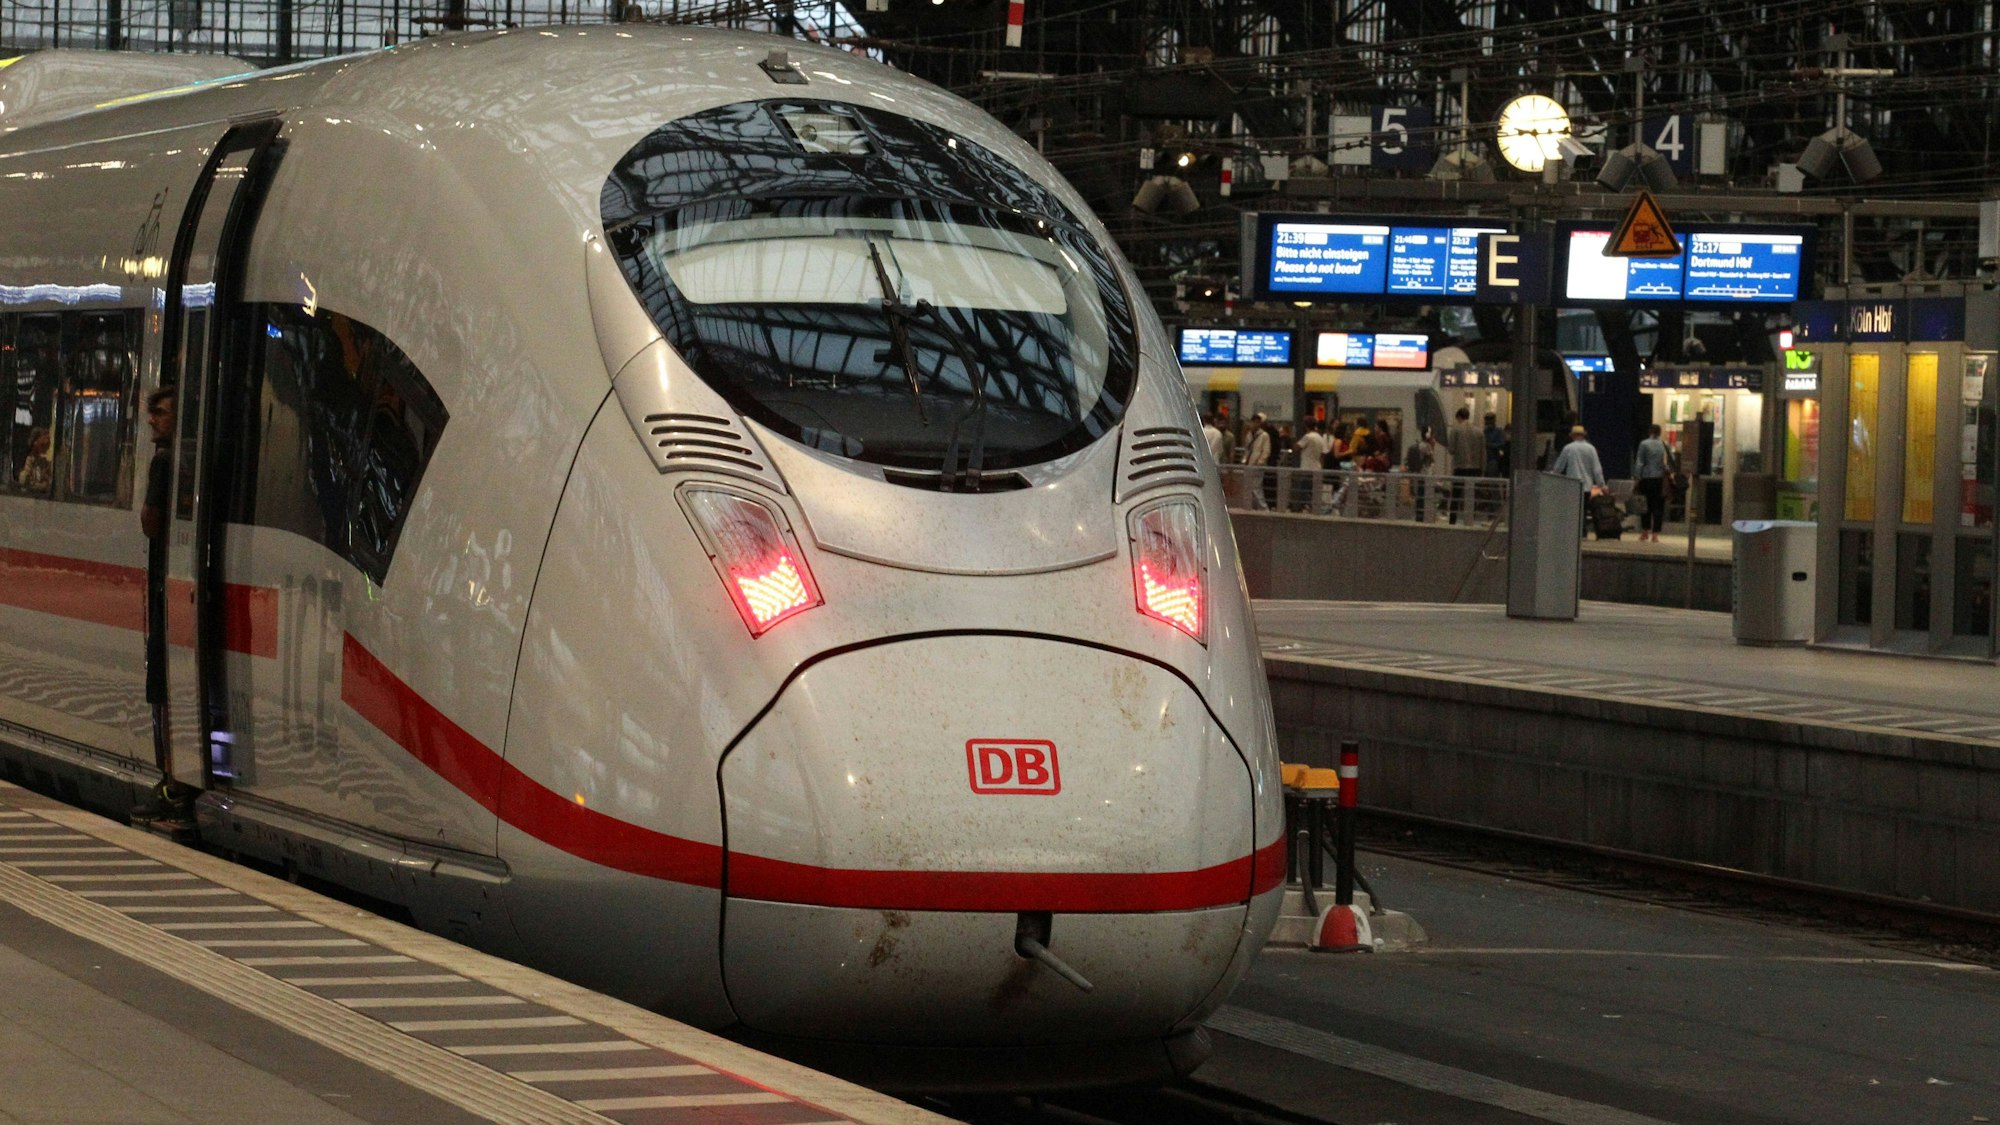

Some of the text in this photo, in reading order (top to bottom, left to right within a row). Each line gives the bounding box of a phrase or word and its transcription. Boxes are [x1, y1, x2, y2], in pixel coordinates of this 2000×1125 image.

[1380, 108, 1408, 154] 5
[1655, 114, 1684, 160] 4
[1277, 232, 1304, 244] 21:39
[1692, 242, 1719, 253] 21:17
[1276, 246, 1369, 262] Bitte nicht einsteigen
[1488, 234, 1520, 286] E
[1691, 256, 1734, 268] Dortmund
[1736, 257, 1752, 268] Hbf
[1275, 260, 1362, 274] Please do not board
[1850, 305, 1893, 333] Köln Hbf
[978, 747, 1049, 785] DB
